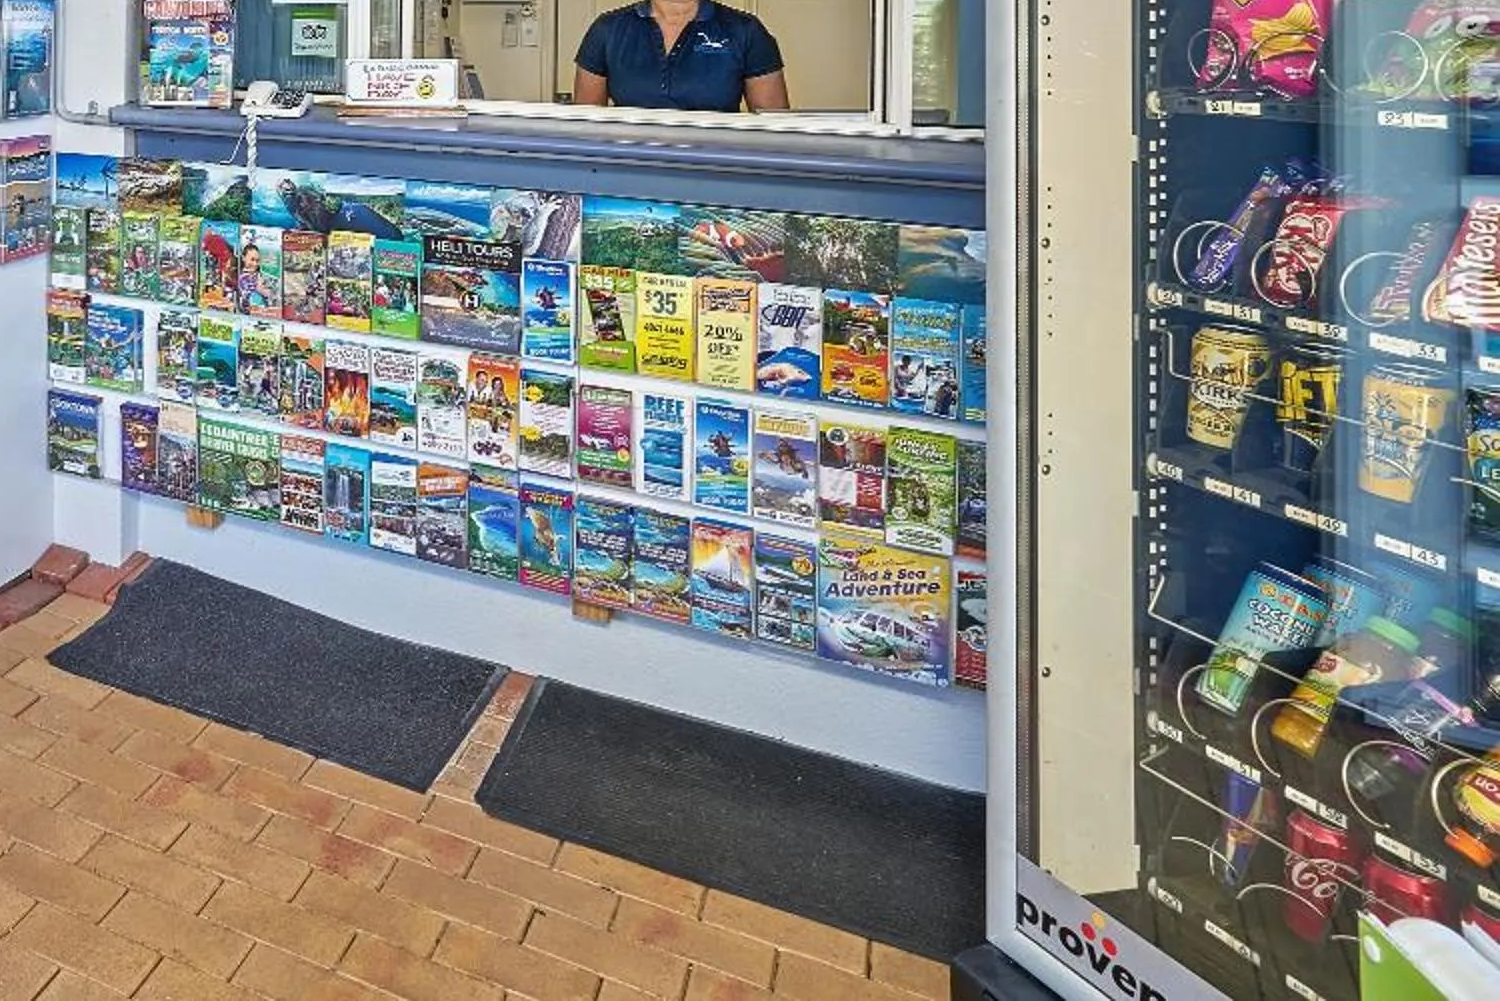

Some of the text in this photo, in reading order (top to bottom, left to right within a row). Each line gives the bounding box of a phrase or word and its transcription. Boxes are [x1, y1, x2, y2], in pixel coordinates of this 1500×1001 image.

[431, 239, 514, 260] HELI TOURS
[703, 324, 743, 342] 20%
[843, 567, 927, 583] Land & Sea
[825, 581, 942, 599] Adventure
